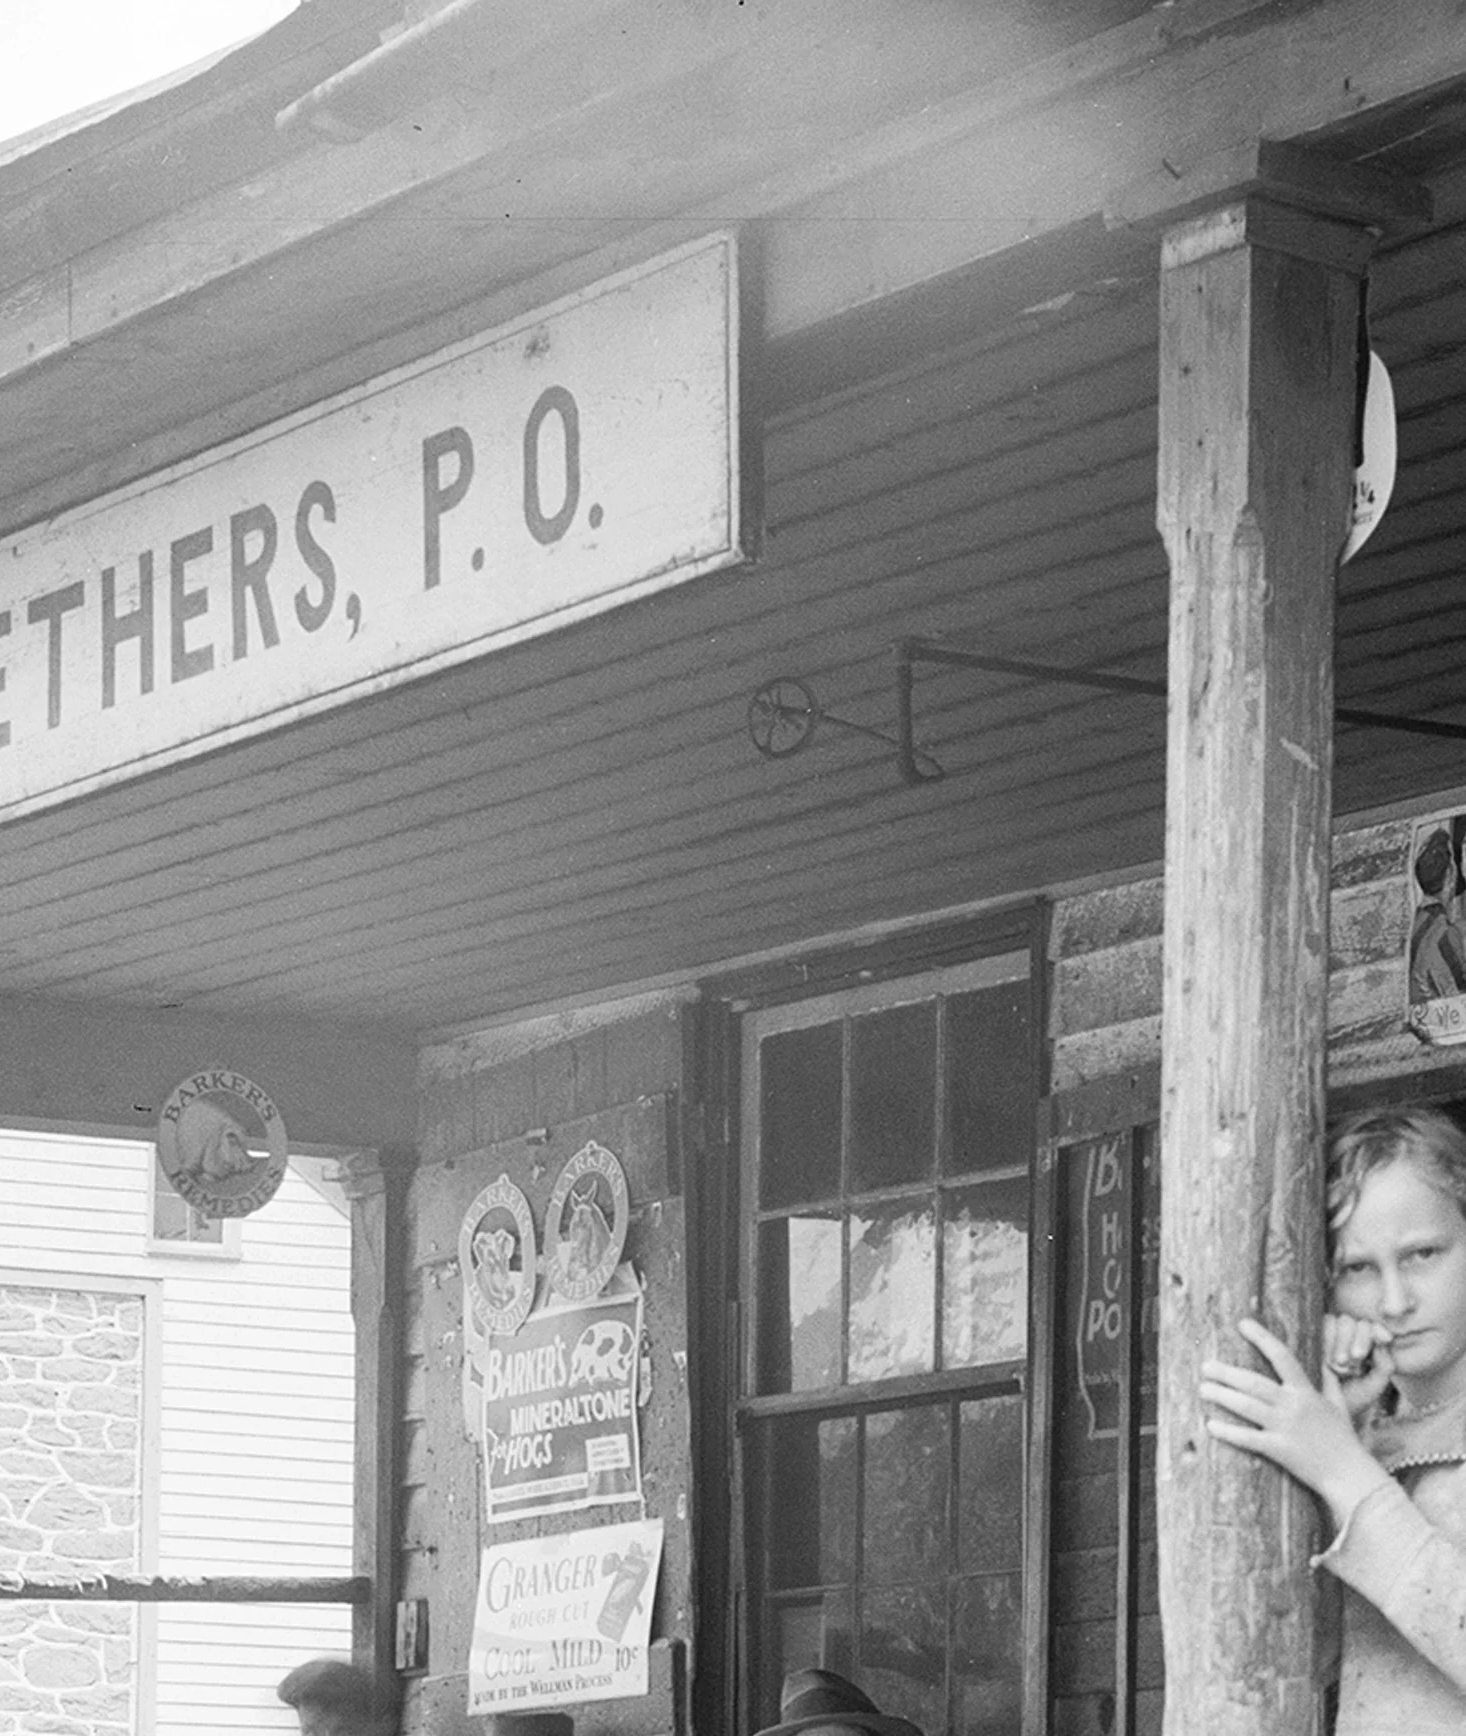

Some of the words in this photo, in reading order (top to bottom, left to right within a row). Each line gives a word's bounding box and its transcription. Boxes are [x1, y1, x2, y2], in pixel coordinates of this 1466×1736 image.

[1434, 1004, 1460, 1028] We
[163, 1072, 277, 1124] BARKER'S
[488, 1334, 567, 1401] BARKER'S
[510, 1387, 631, 1436] MINERALTONE
[504, 1432, 553, 1475] HOGS
[486, 1554, 598, 1614] GRANGER
[510, 1607, 558, 1631] ROUGH
[562, 1600, 590, 1623] CUT
[484, 1646, 536, 1681] COOL
[549, 1638, 603, 1672] MILD
[498, 1687, 509, 1701] BY
[511, 1684, 528, 1699] THE
[529, 1676, 574, 1695] WELLMAN
